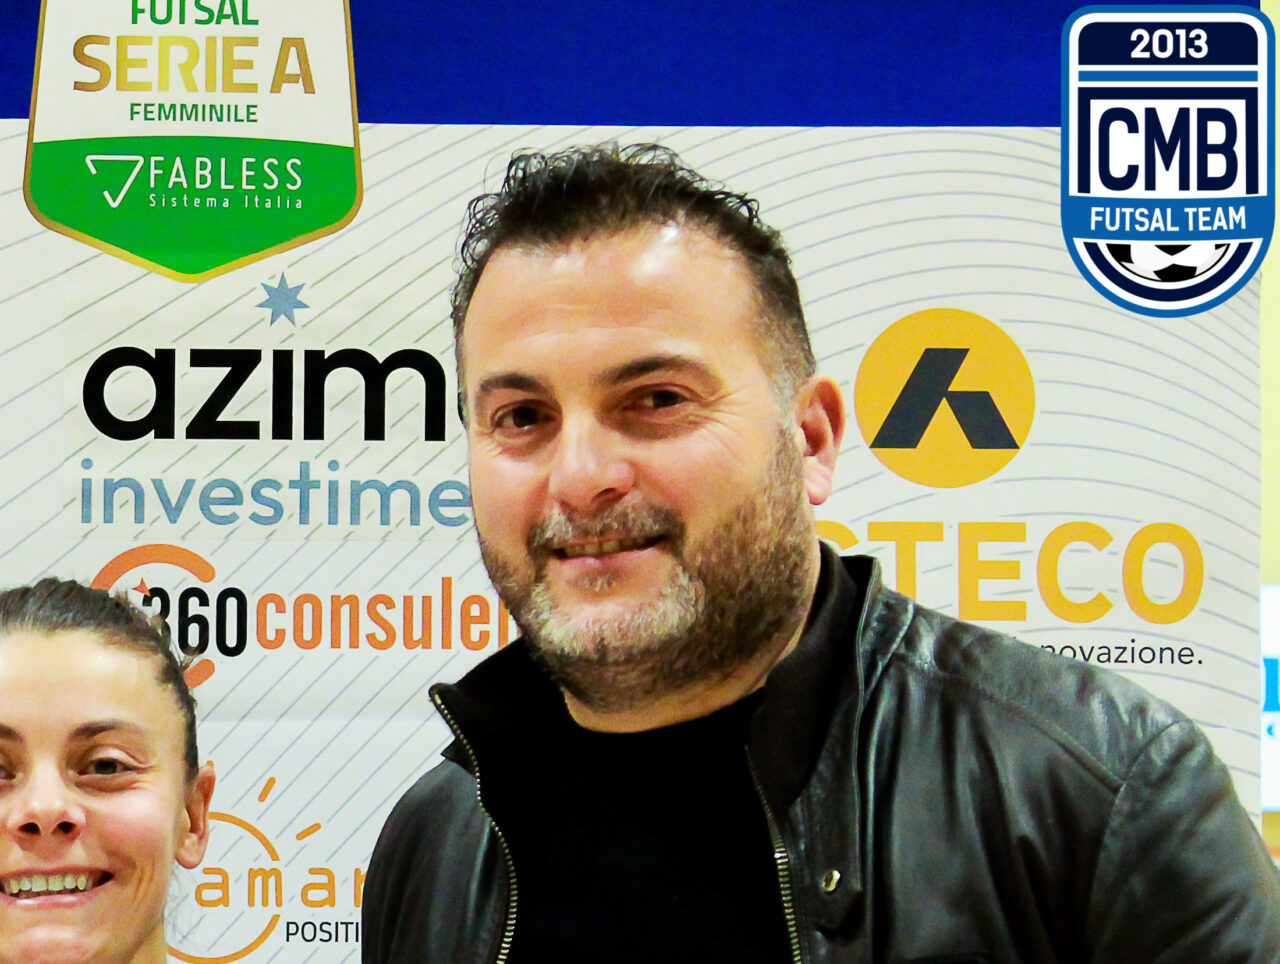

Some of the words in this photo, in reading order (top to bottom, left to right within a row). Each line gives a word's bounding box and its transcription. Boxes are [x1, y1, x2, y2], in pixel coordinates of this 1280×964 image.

[73, 35, 259, 92] SERIE
[269, 37, 316, 94] A
[130, 103, 258, 122] FEMMINILE
[150, 156, 302, 190] FABLESS
[149, 194, 229, 208] Sistema
[245, 195, 303, 209] Italia
[80, 458, 472, 527] investime
[286, 921, 360, 943] POSITI
